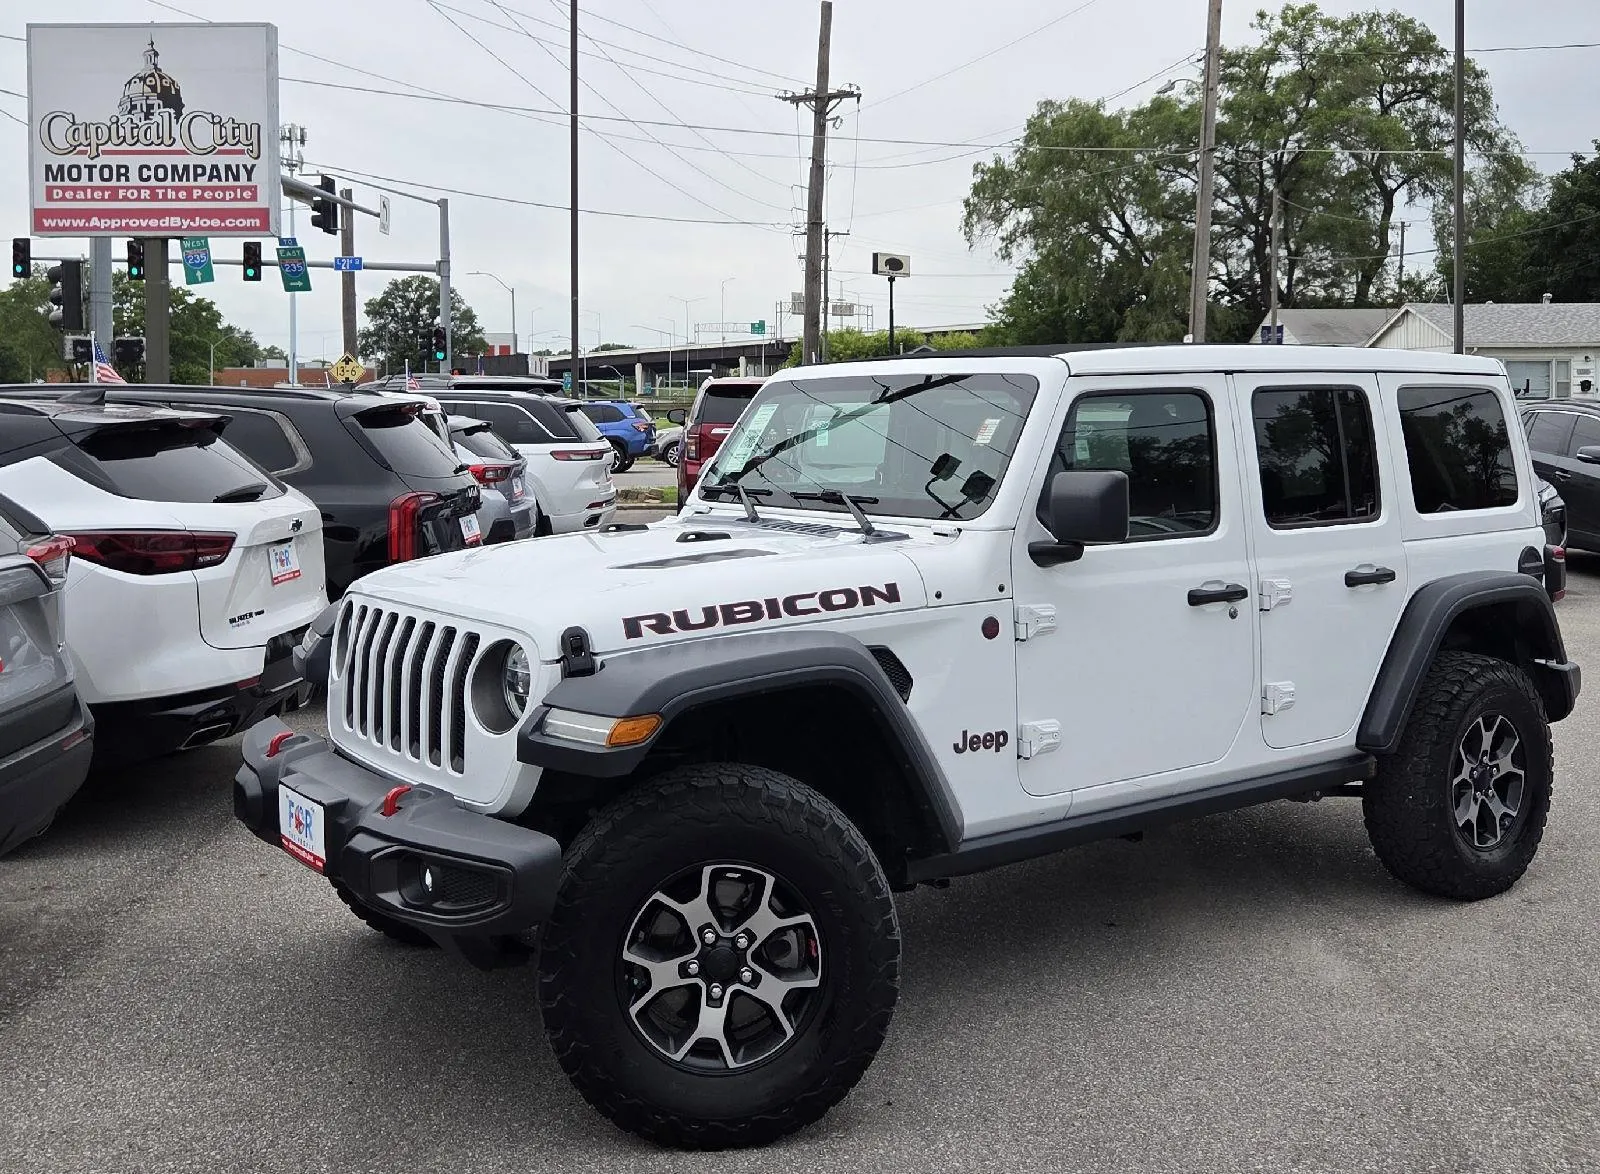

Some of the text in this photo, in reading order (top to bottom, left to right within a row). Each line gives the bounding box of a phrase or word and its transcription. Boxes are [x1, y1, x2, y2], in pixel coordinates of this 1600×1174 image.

[40, 110, 261, 160] Capital City
[44, 163, 257, 183] MOTOR COMPANY
[52, 188, 252, 201] Dealer FOR The People
[42, 215, 261, 229] www.ApprovedByJoe.com
[183, 239, 205, 248] WEST
[188, 253, 207, 264] 235
[279, 249, 301, 257] EAST
[284, 263, 303, 273] 235
[622, 582, 901, 640] RUBICON
[953, 729, 1009, 754] Jeep
